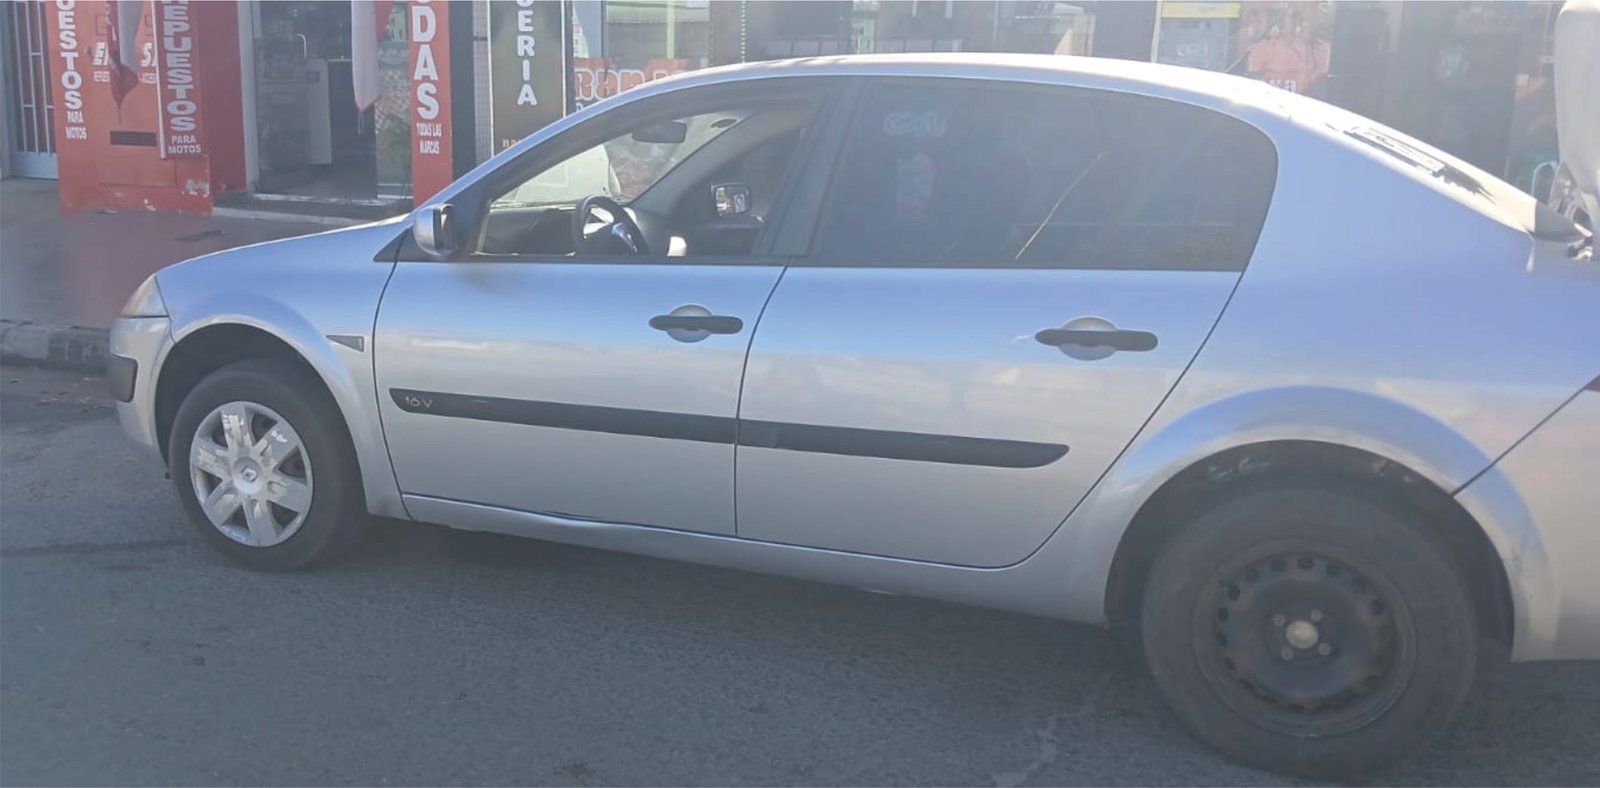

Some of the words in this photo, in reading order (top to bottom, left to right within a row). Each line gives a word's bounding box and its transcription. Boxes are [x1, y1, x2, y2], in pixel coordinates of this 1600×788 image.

[163, 0, 197, 131] EPUESTOS
[412, 0, 439, 120] DAS
[67, 111, 84, 124] PARA
[66, 127, 87, 140] MOTOS
[172, 135, 196, 144] PARA
[168, 144, 202, 154] MOTOS
